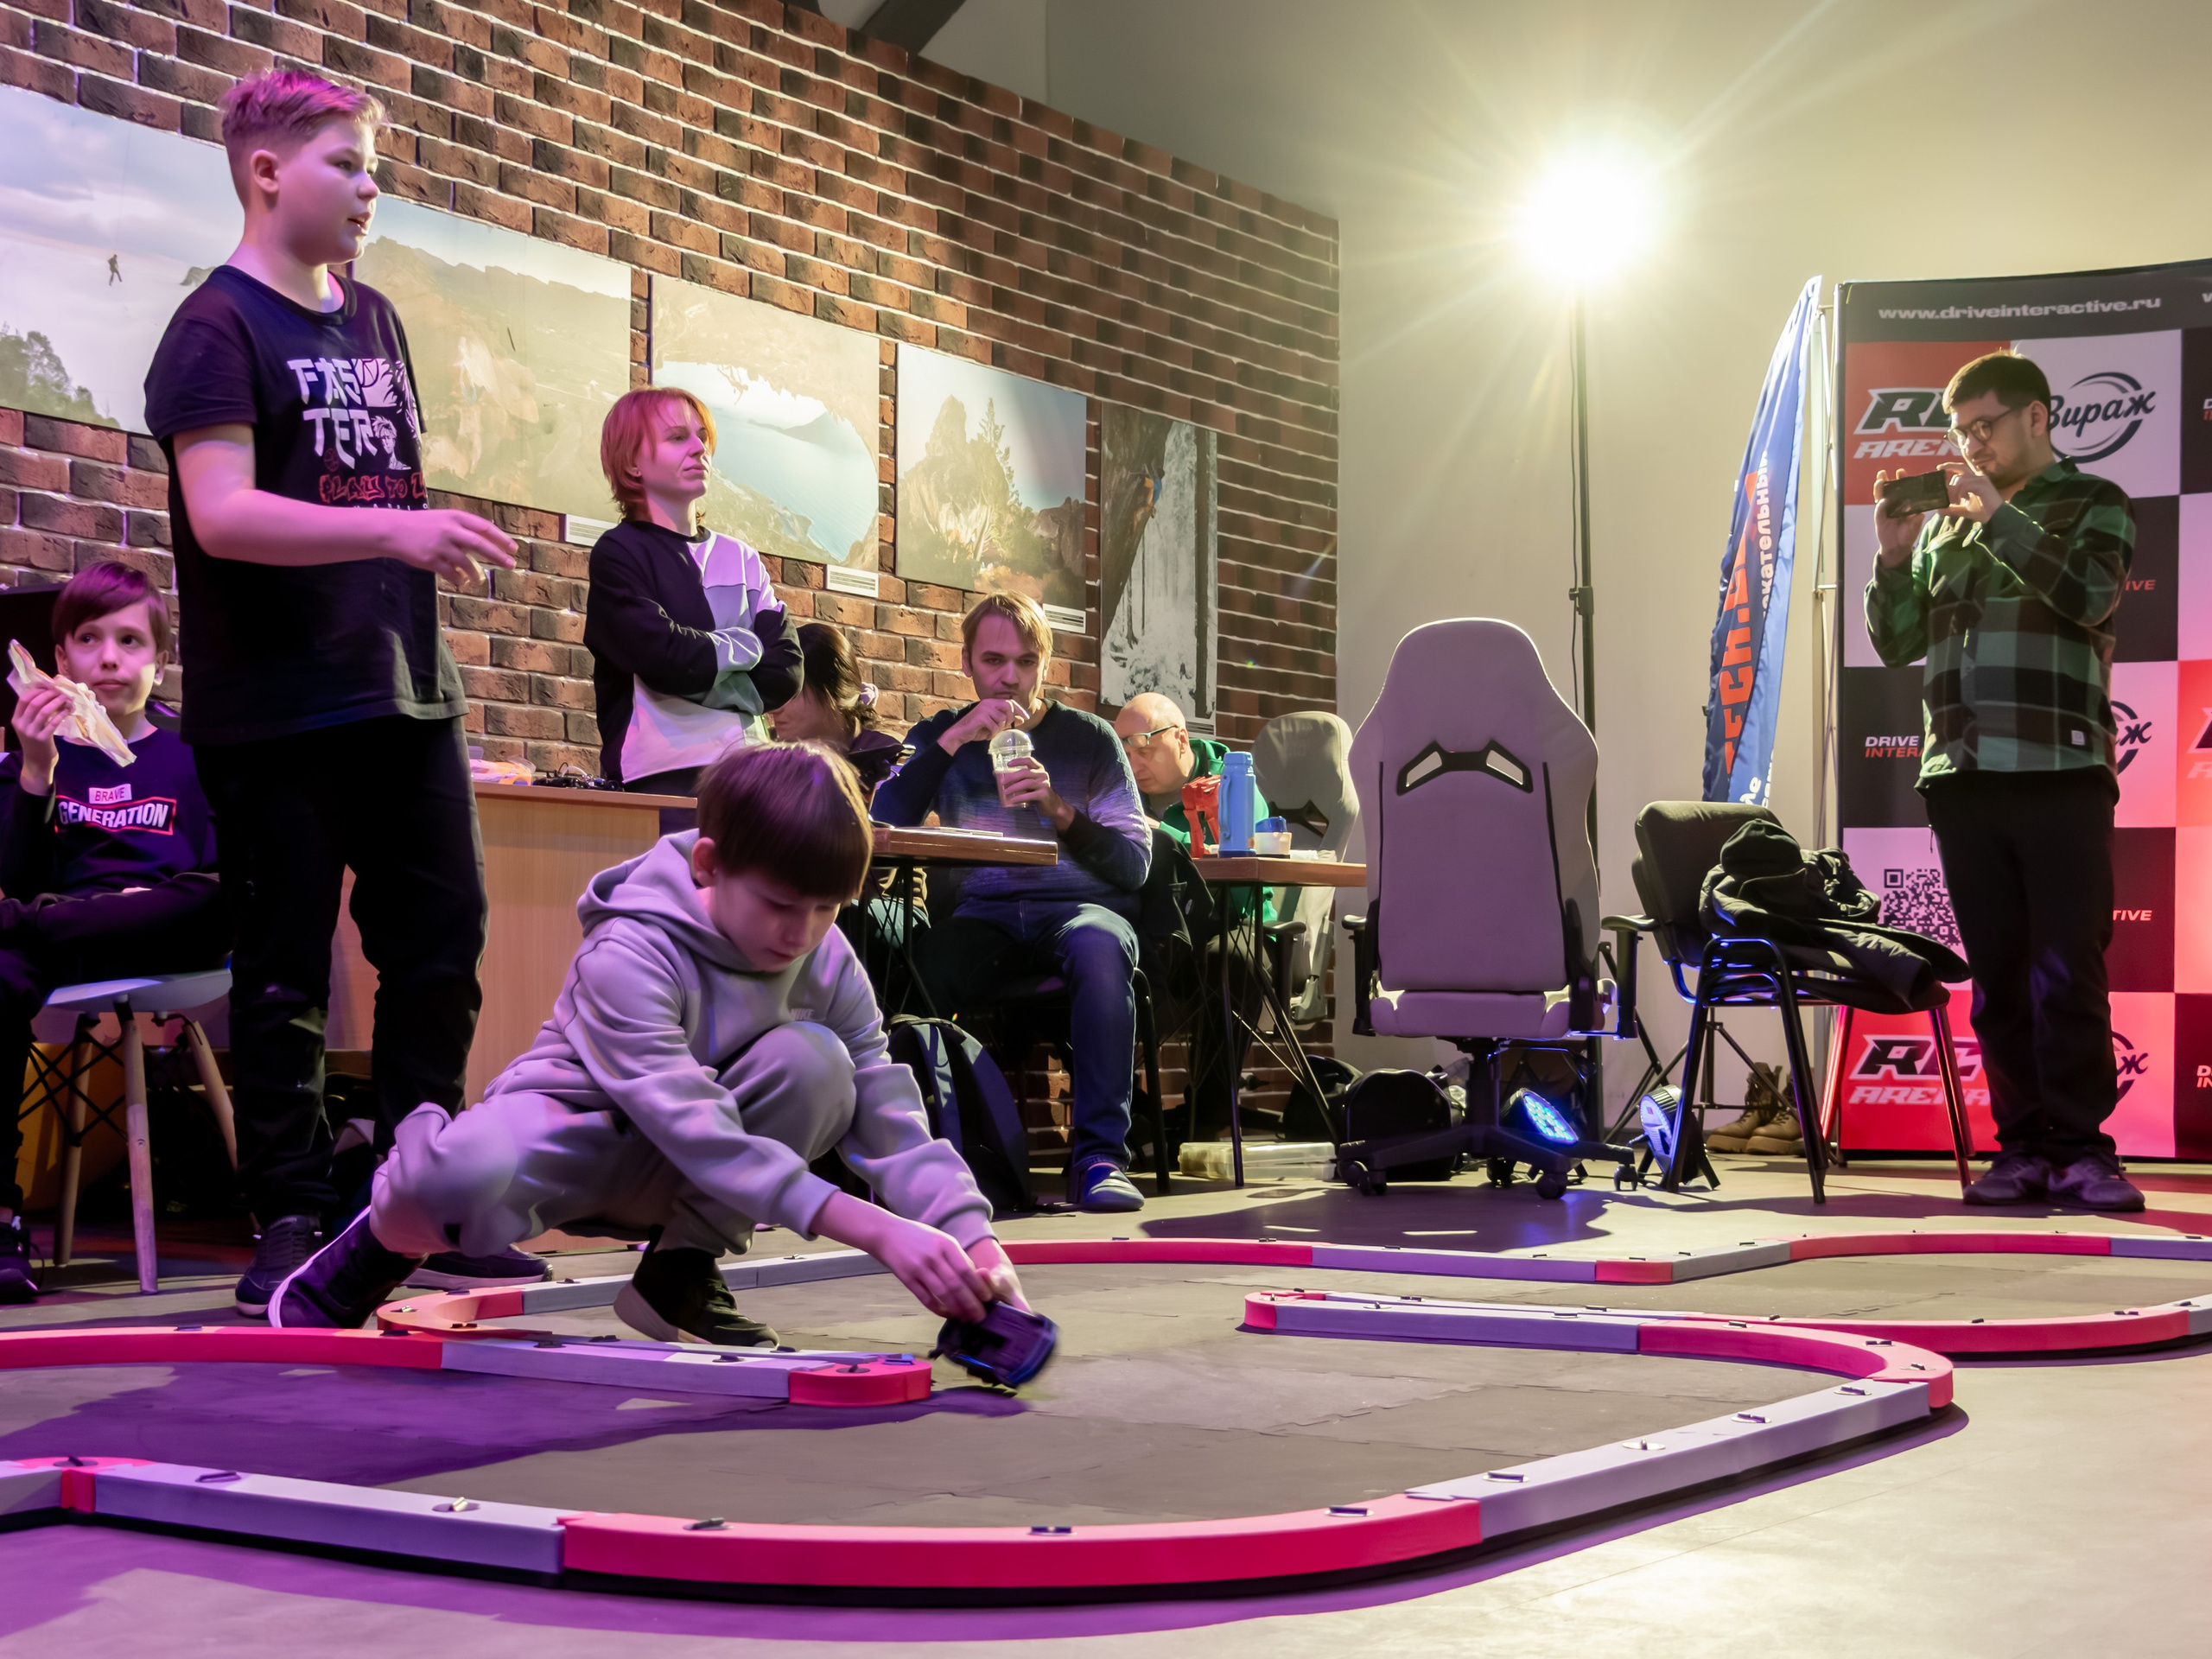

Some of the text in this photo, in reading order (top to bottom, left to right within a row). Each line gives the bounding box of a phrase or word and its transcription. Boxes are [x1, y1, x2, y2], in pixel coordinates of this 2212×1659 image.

[1878, 297, 2162, 319] www.driveinteractive.ru
[302, 408, 378, 469] TER
[1853, 439, 1963, 459] AREN
[1865, 735, 1919, 747] DRIVE
[94, 787, 126, 802] BRAVE
[58, 801, 169, 828] GENERATION
